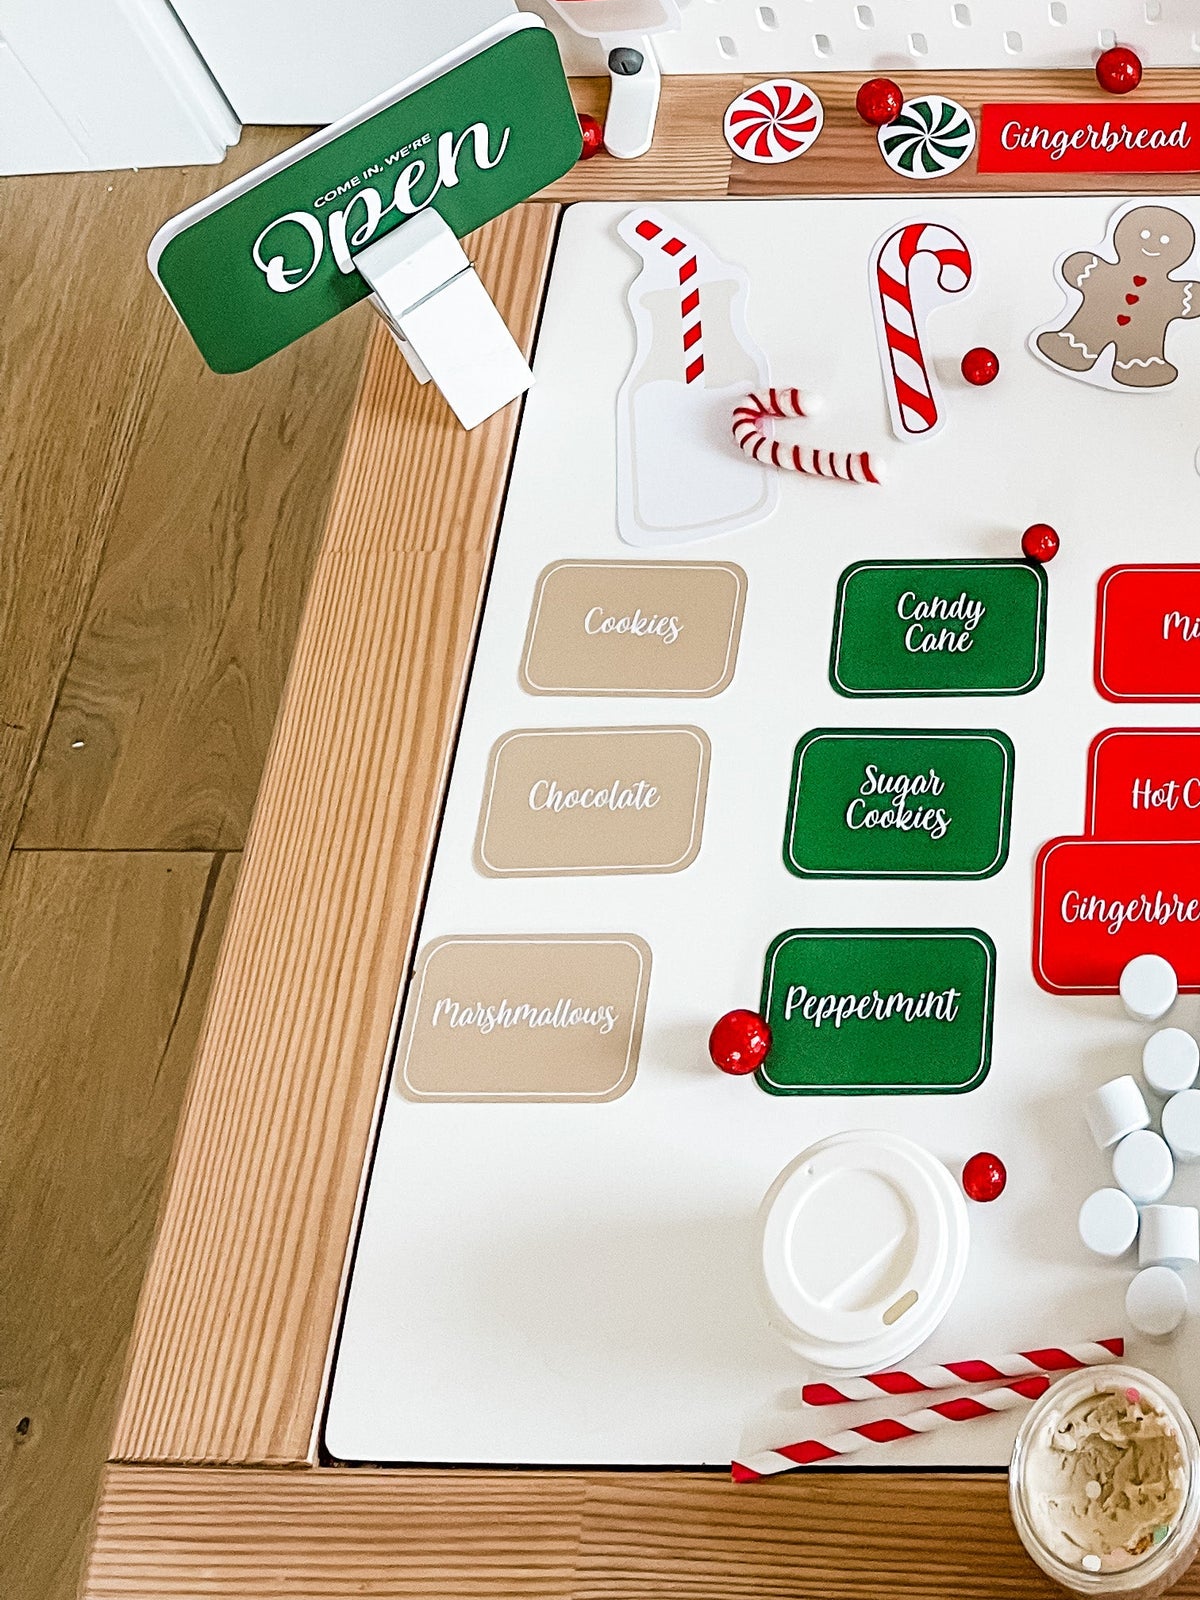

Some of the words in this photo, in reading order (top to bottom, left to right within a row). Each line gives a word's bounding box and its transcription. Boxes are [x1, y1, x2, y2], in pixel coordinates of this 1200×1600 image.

[1001, 120, 1191, 161] Gingerbread
[313, 176, 362, 209] COME
[363, 162, 385, 182] IN,
[384, 133, 432, 165] WE'RE
[252, 122, 511, 293] Open
[583, 606, 684, 645] Cookies
[897, 591, 986, 630] Candy
[905, 623, 974, 653] Cane
[528, 779, 661, 813] Chocolate
[859, 764, 946, 808] Sugar
[1132, 778, 1180, 811] Hot
[846, 799, 952, 840] Cookies
[432, 997, 619, 1035] Marshmallows
[785, 985, 961, 1029] Peppermint
